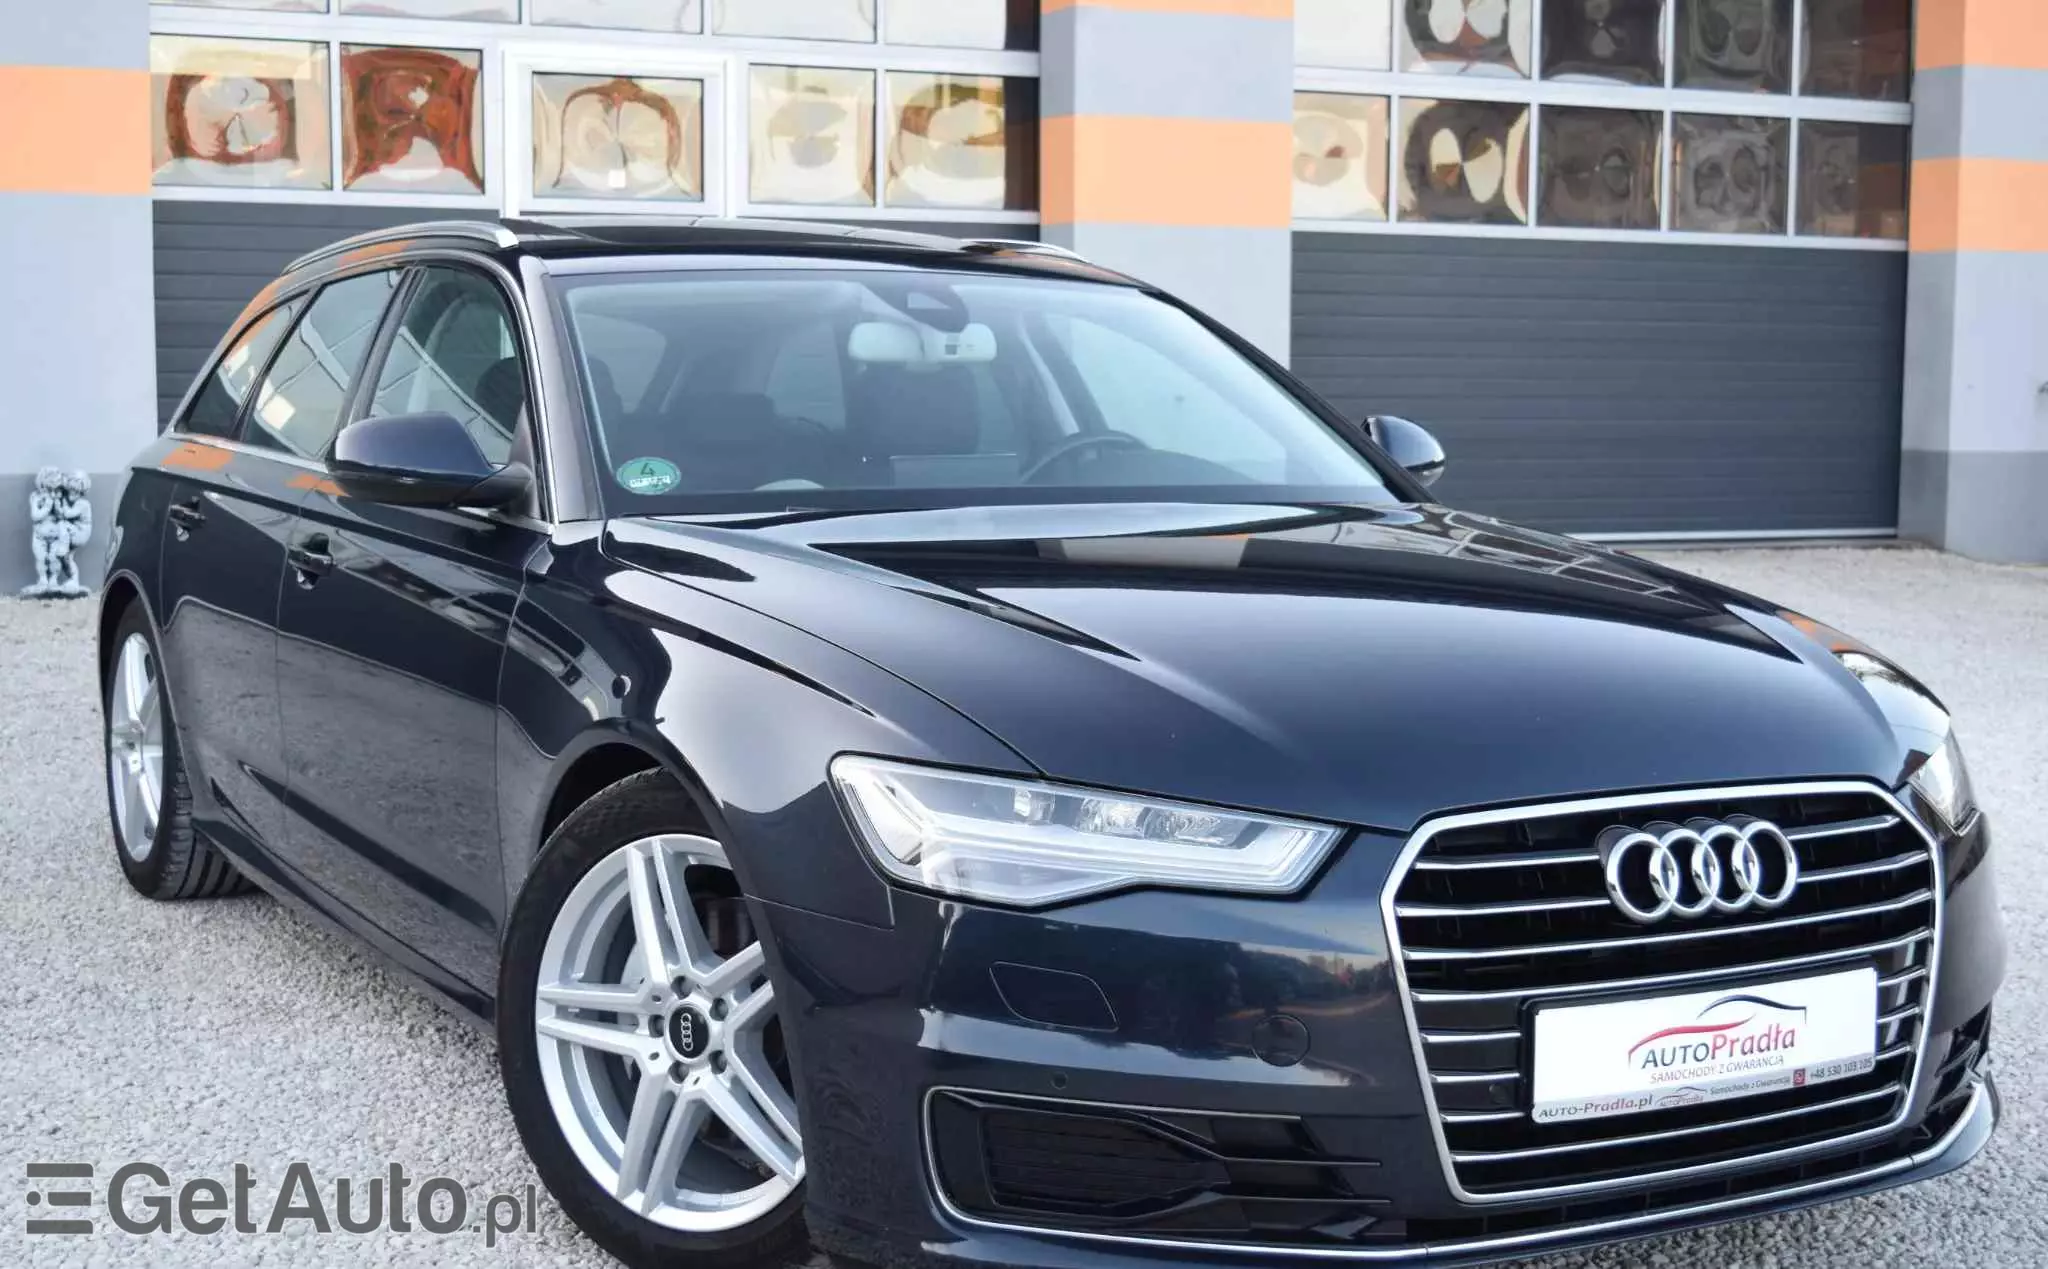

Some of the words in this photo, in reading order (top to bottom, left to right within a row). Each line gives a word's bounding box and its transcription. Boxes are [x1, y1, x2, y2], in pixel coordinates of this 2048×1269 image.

[1650, 1064, 1715, 1084] SAMOCHODY
[1718, 1064, 1726, 1074] Z
[1810, 1068, 1824, 1080] +48
[1827, 1065, 1841, 1077] 530
[1844, 1062, 1857, 1073] 103
